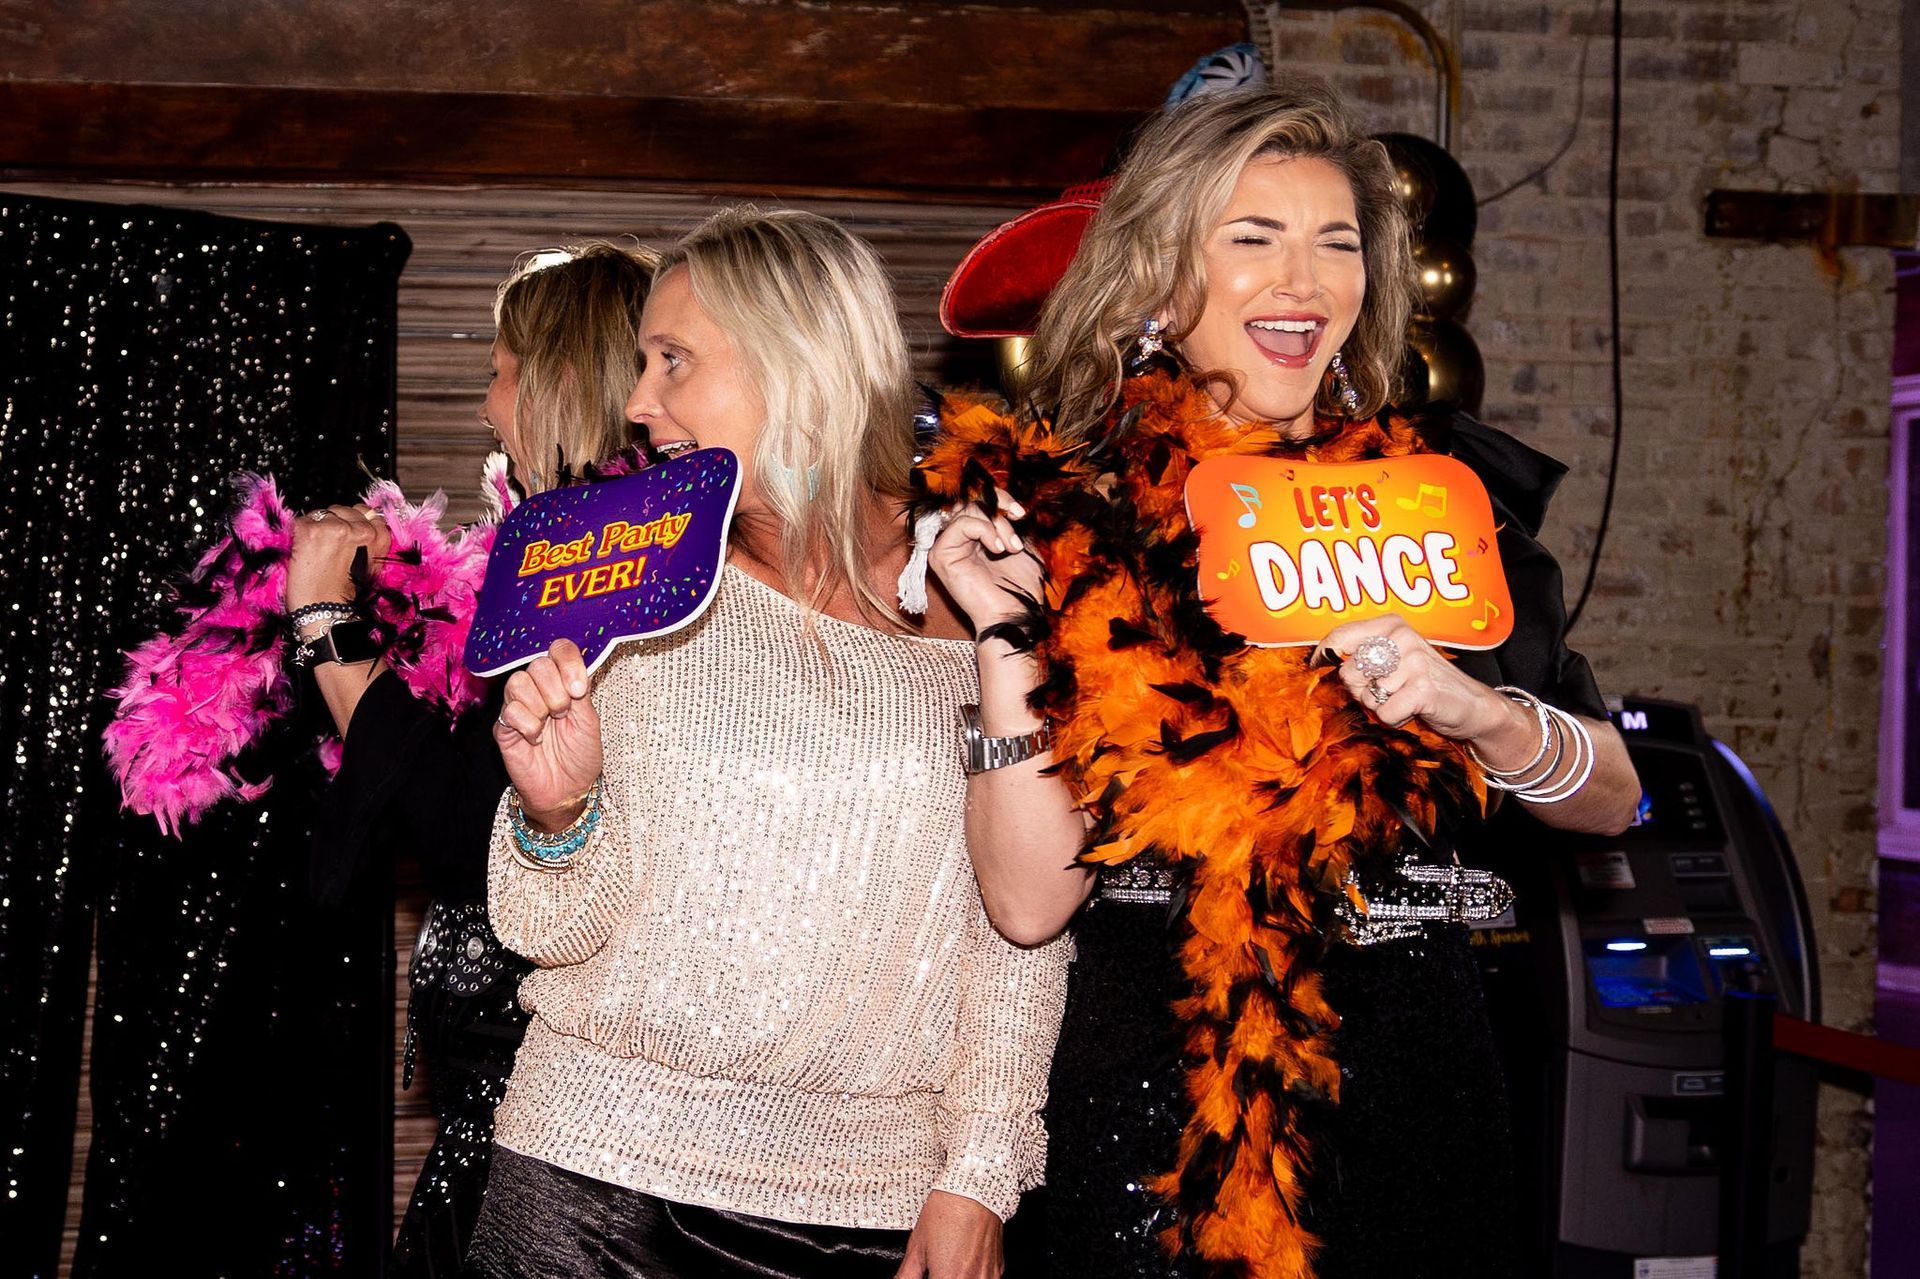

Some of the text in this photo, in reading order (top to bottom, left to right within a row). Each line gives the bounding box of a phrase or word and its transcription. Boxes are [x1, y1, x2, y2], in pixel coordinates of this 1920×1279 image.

[1294, 483, 1381, 531] LET'S
[518, 512, 692, 576] Best Party
[537, 556, 647, 608] EVER!
[1249, 531, 1474, 617] DANCE
